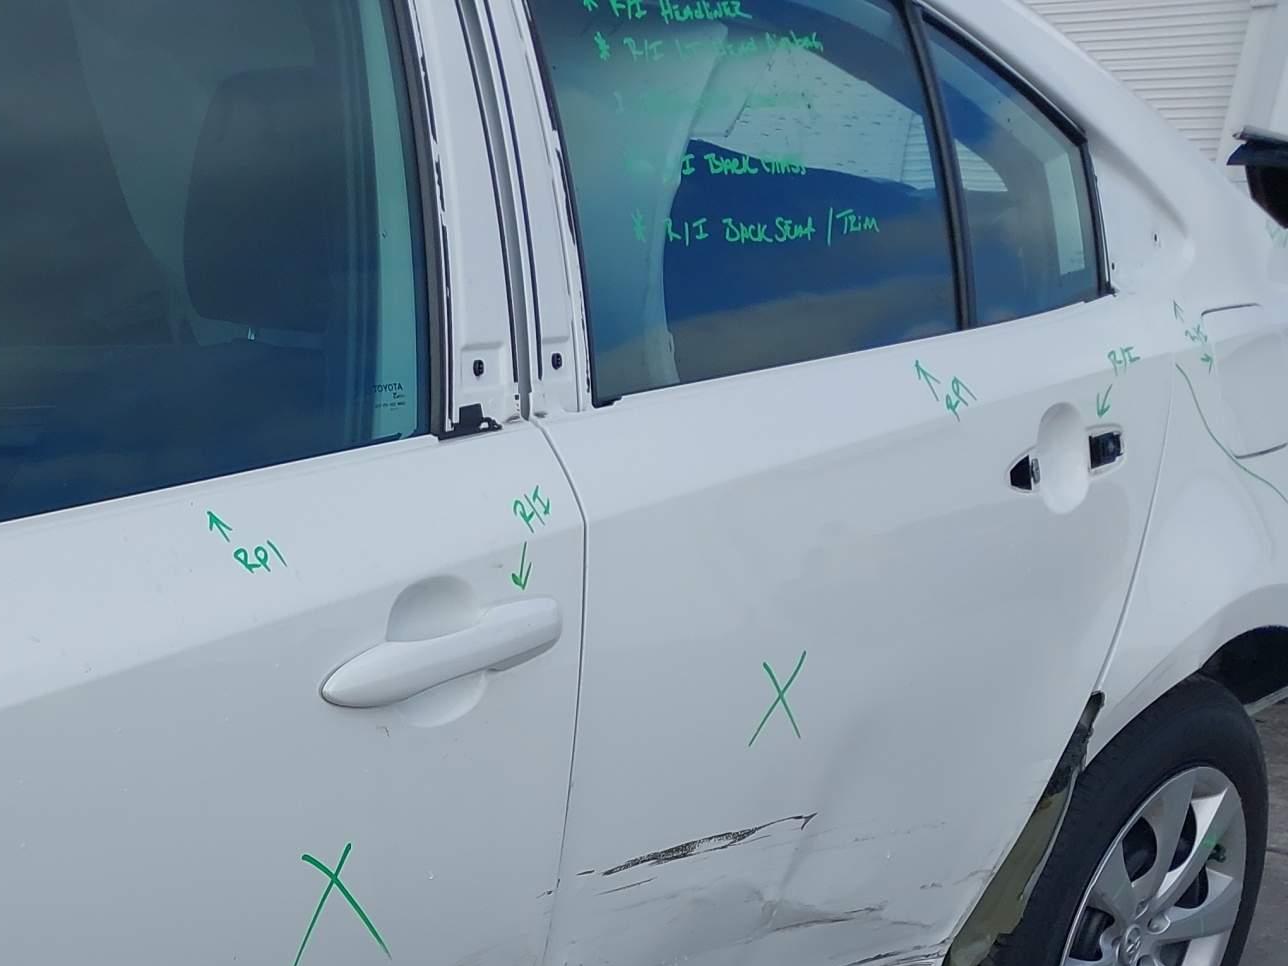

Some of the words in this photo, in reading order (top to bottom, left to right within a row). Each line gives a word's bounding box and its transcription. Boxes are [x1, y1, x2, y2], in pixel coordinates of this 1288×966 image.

[1107, 345, 1141, 376] R/I
[372, 382, 404, 393] TOYOTA
[512, 485, 551, 534] R/I
